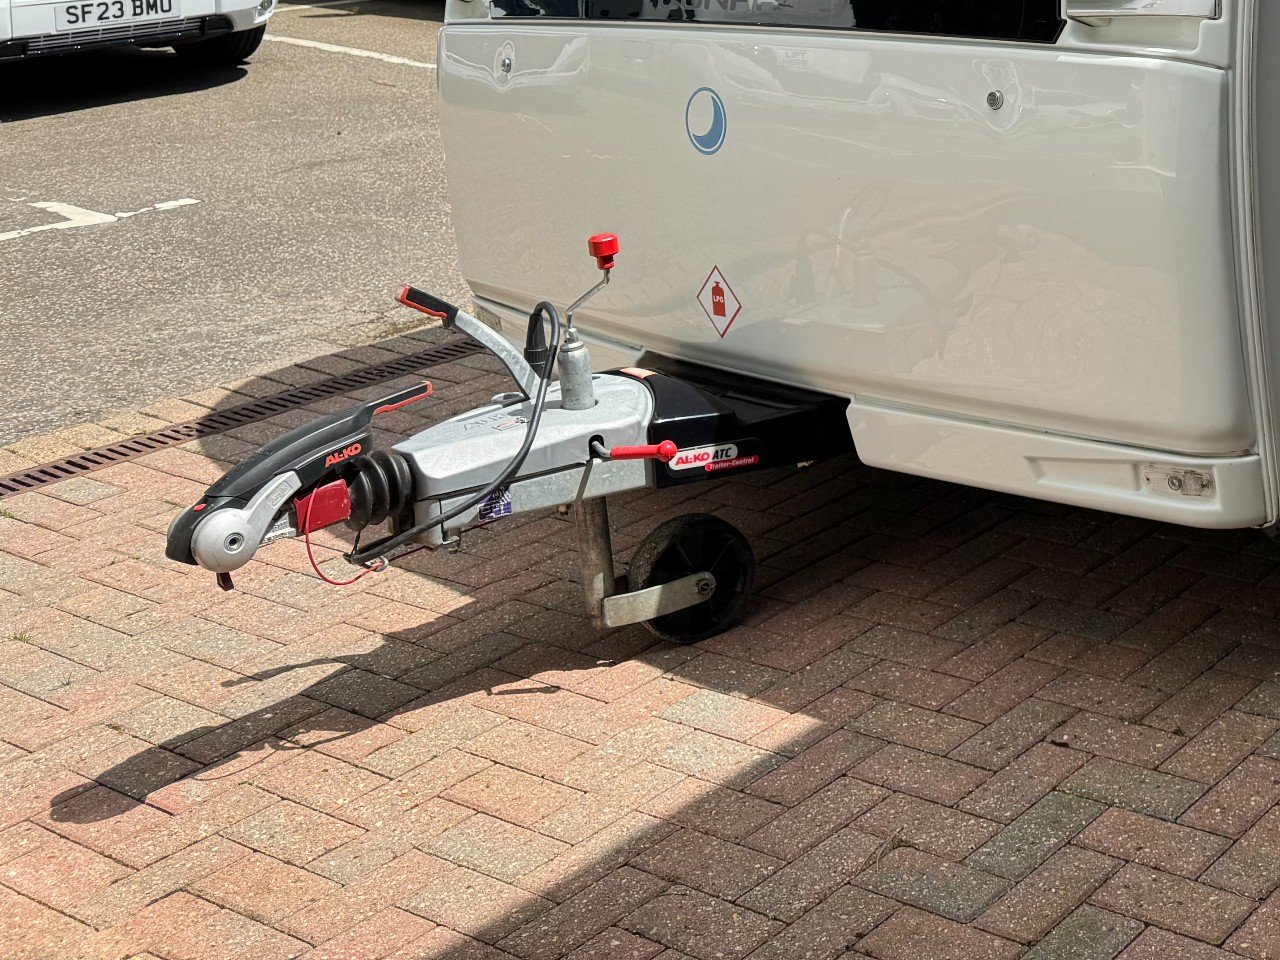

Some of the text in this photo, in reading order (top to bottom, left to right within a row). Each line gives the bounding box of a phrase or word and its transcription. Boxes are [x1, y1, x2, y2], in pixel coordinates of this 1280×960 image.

[65, 0, 125, 25] SF23
[785, 50, 807, 59] LIFT
[713, 294, 724, 303] LPG
[324, 442, 362, 468] AL-KO
[675, 447, 733, 467] AL-KO ATC
